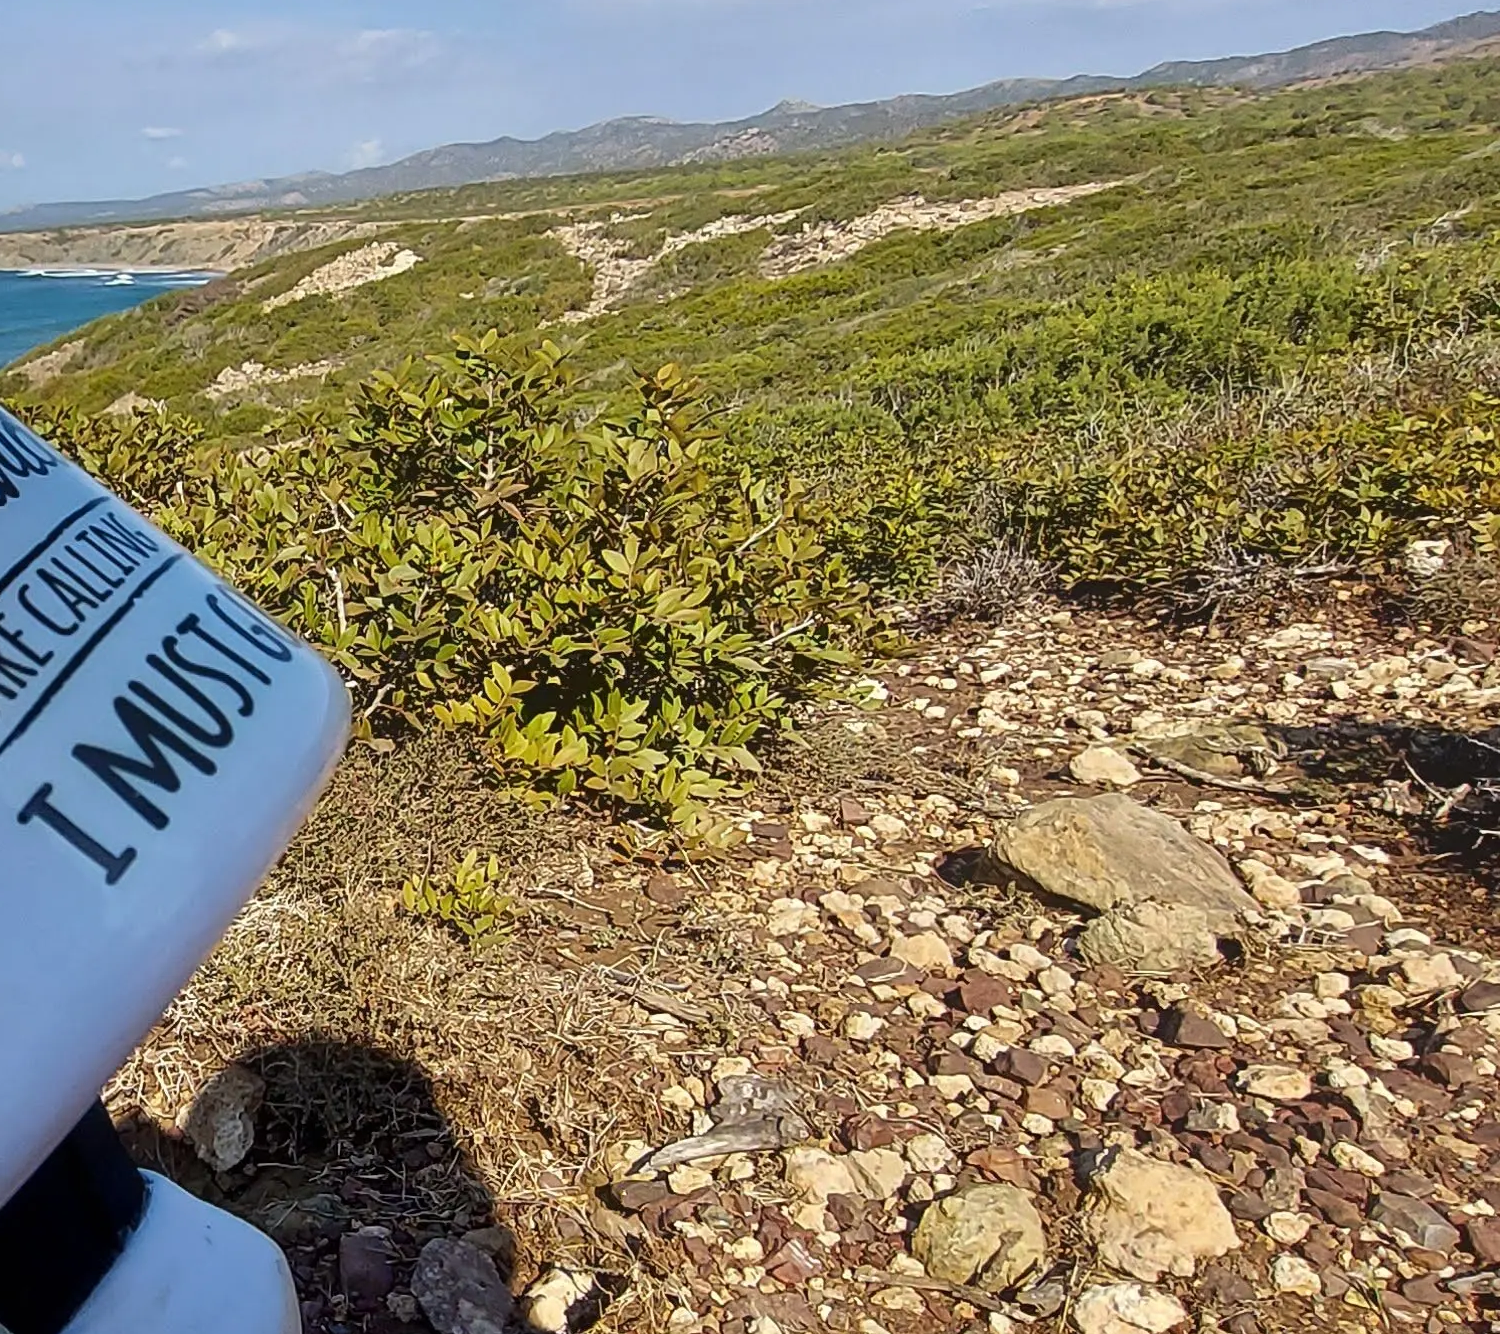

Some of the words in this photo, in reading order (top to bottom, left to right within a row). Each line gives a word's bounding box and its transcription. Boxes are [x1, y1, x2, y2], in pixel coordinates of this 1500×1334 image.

[18, 512, 159, 635] CALLING
[71, 613, 271, 830] MUST
[16, 782, 137, 885] I
